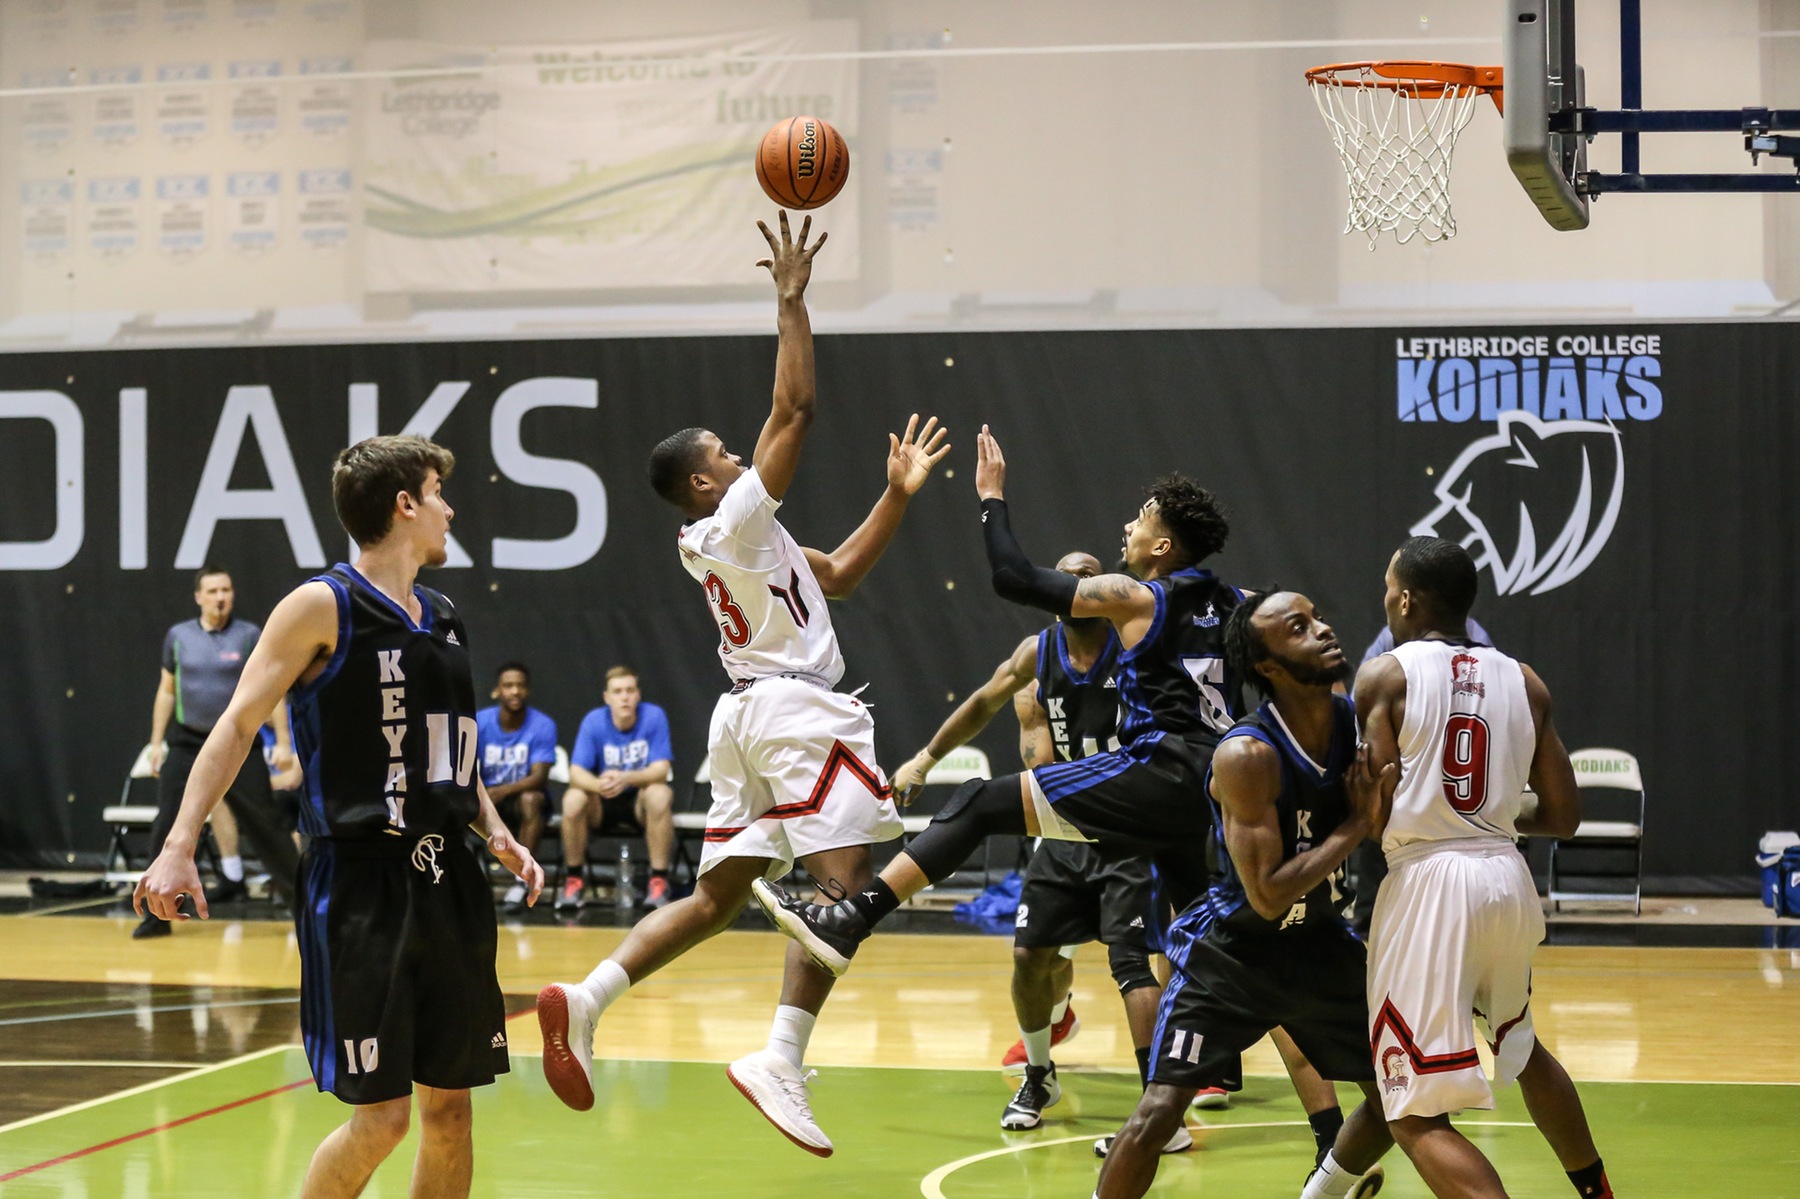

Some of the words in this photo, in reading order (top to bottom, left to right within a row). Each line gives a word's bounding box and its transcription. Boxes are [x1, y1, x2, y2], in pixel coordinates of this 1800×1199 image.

[798, 122, 816, 179] Wilson
[1396, 336, 1549, 358] LETHBRIDGE
[1556, 335, 1661, 356] COLLEGE
[1397, 356, 1663, 423] KODIAKS
[377, 649, 408, 836] KEYAN
[425, 713, 478, 788] 10
[1441, 712, 1491, 816] 9
[1572, 758, 1631, 773] KODIAKS
[344, 1037, 379, 1074] 10
